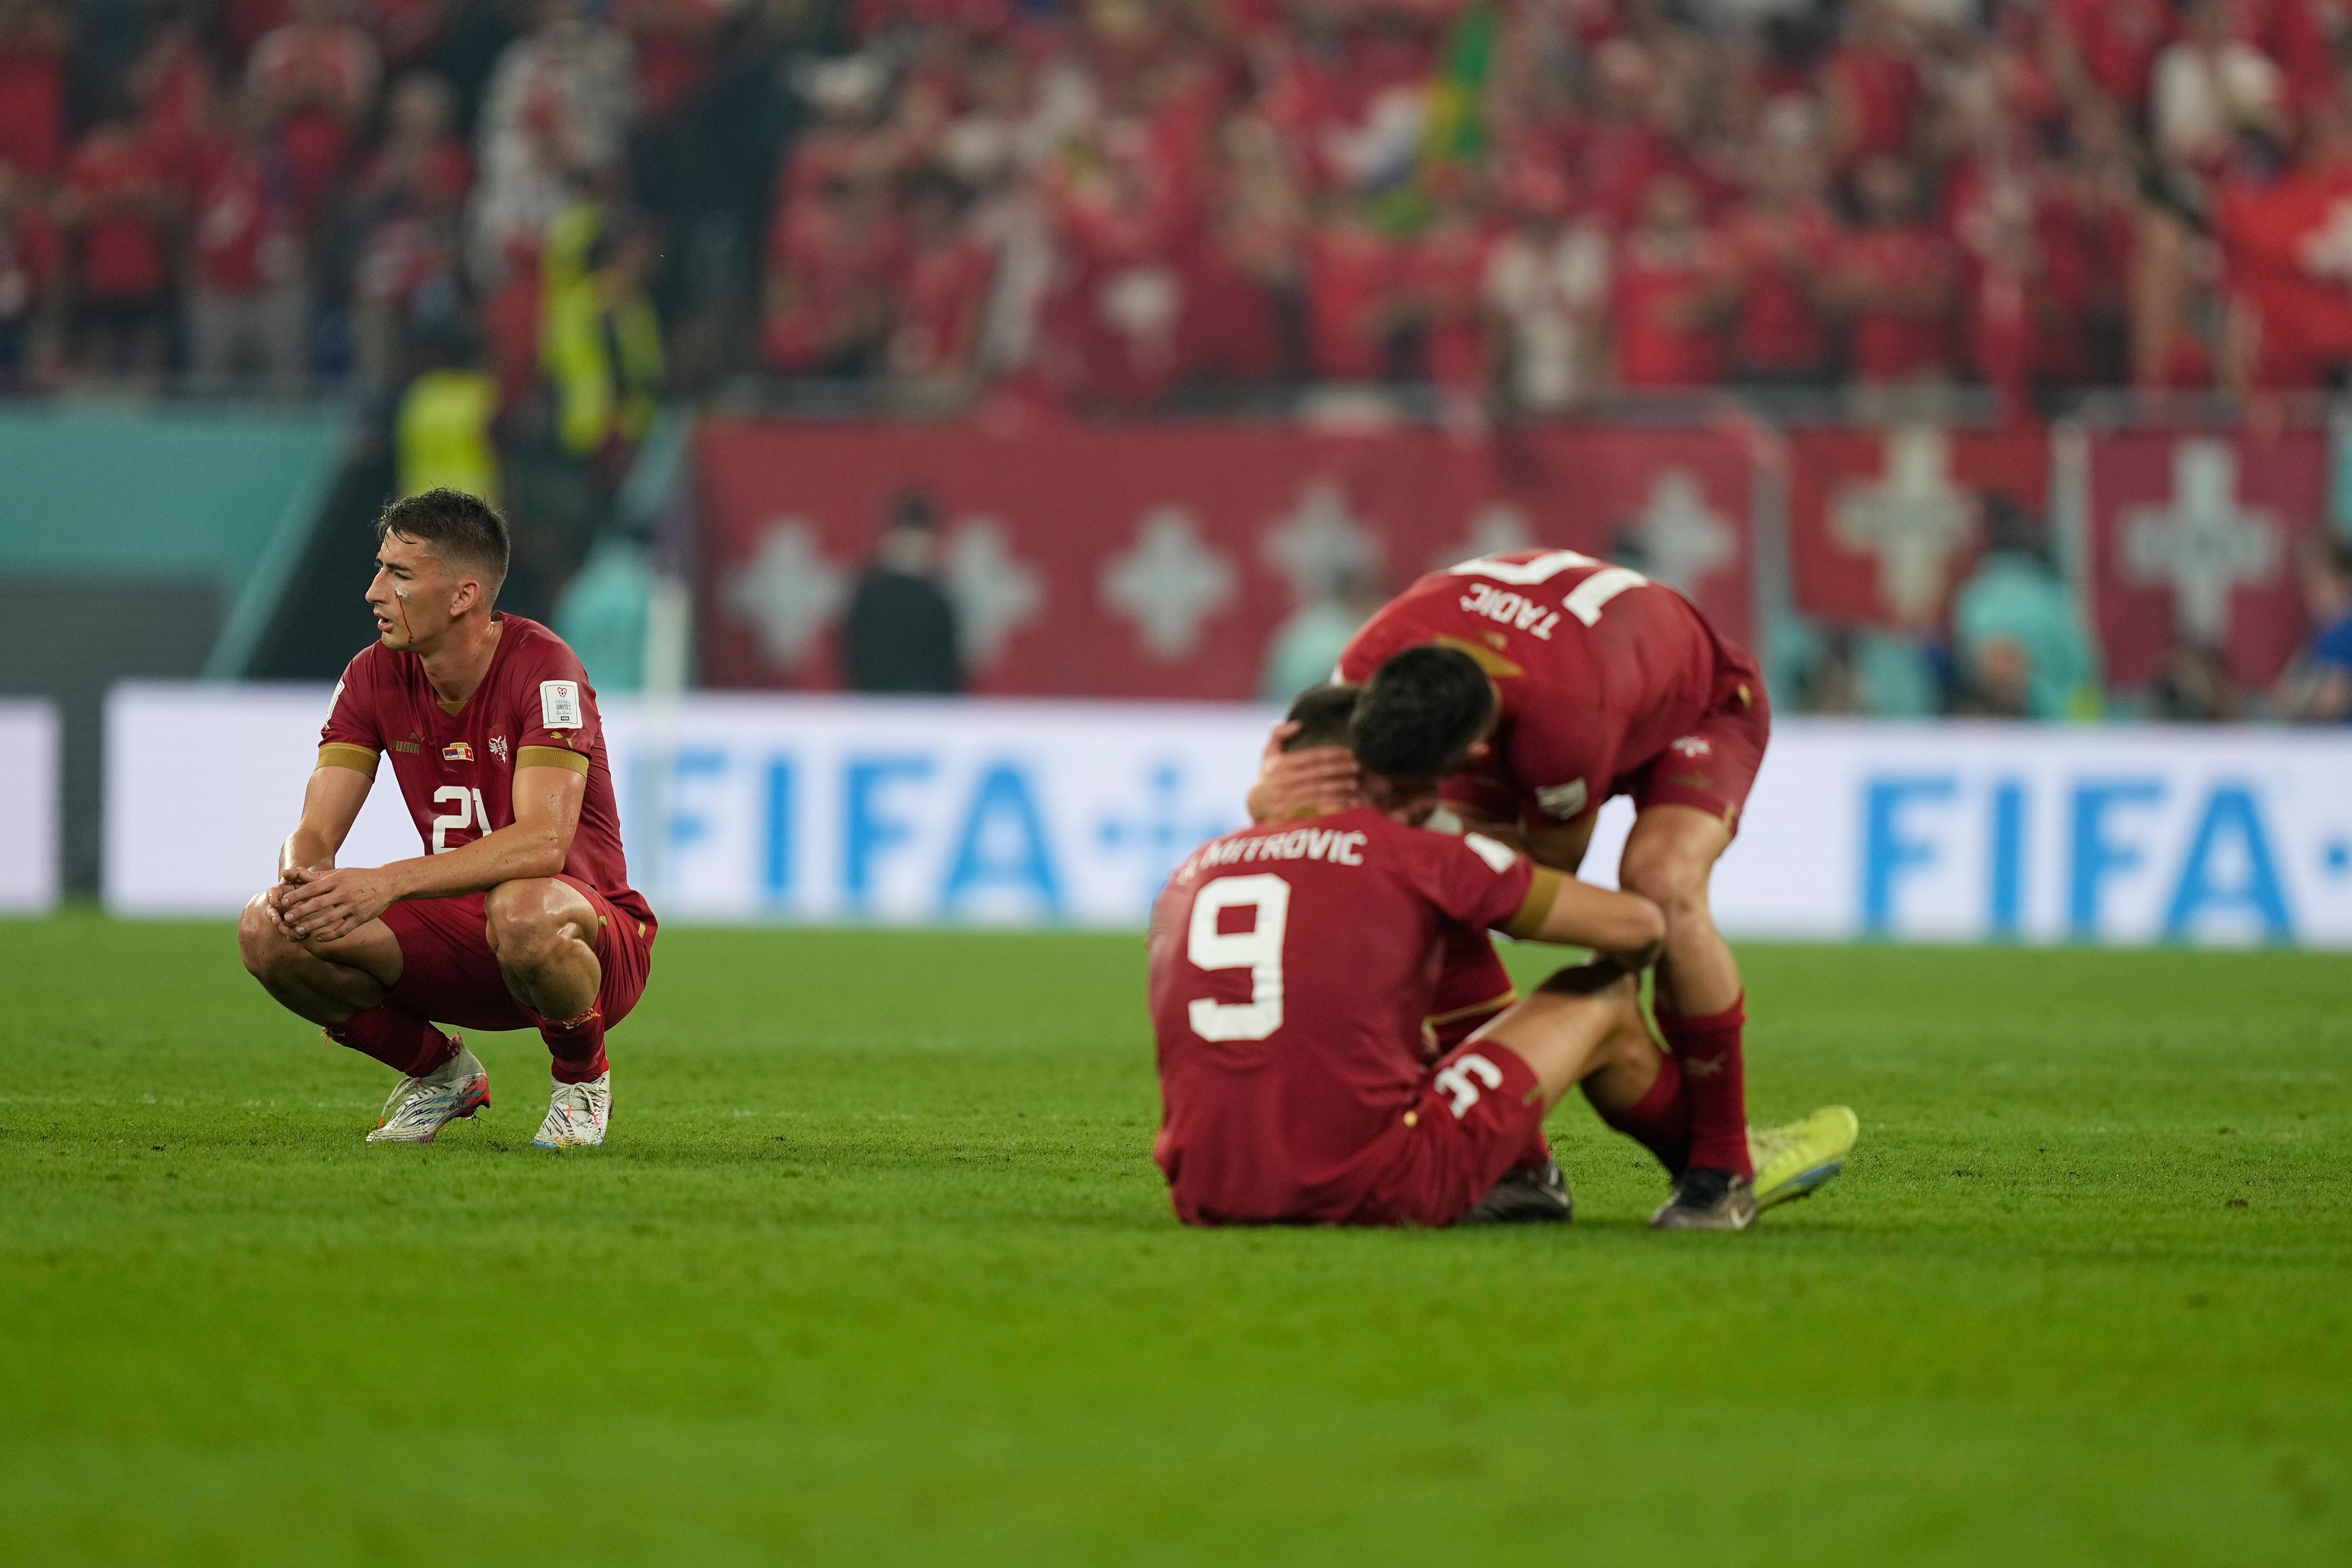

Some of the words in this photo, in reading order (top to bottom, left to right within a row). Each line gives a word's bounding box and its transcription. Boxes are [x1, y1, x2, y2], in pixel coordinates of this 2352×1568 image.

[1459, 583, 1561, 640] TADIĆ
[390, 740, 420, 754] PUMA
[432, 785, 492, 855] 21
[637, 750, 1058, 908] FIFA
[1864, 771, 2298, 935] FIFA
[1187, 872, 1291, 1043] 9
